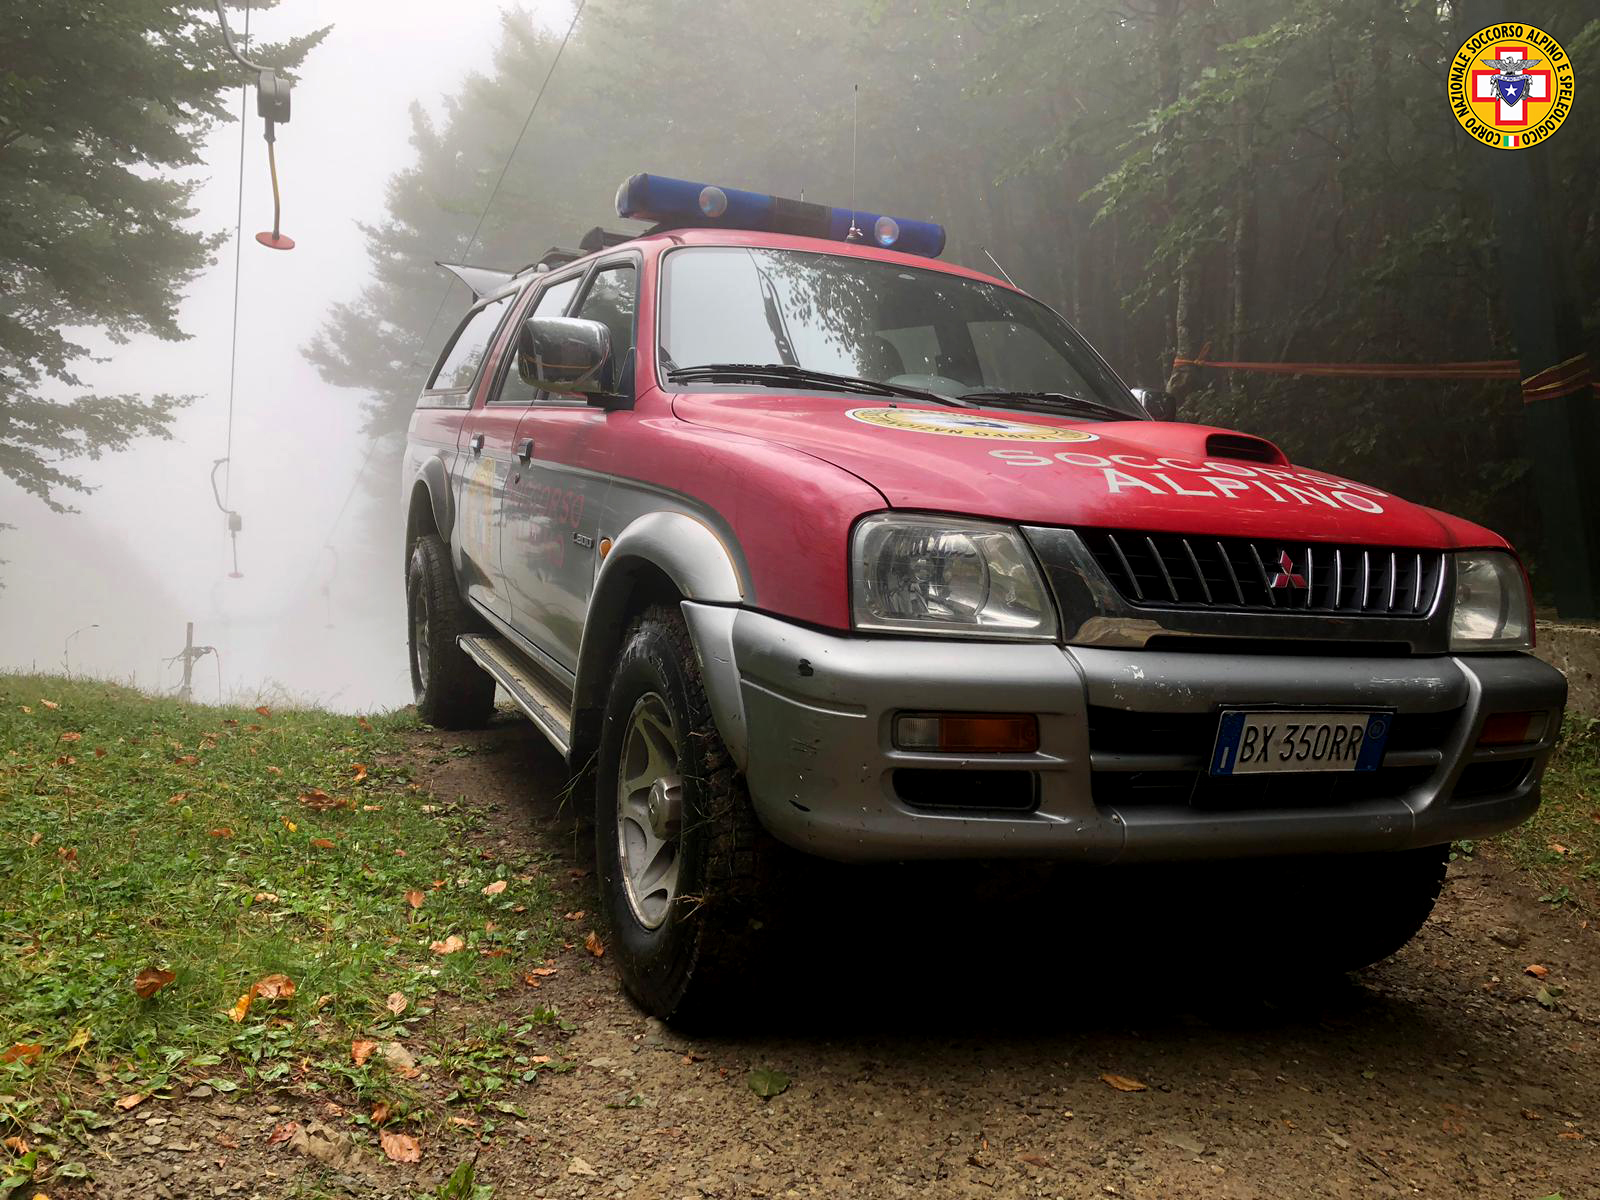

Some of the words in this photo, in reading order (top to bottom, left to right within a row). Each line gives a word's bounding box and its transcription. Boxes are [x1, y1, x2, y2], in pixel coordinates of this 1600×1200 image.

[988, 449, 1389, 498] SOCCORSO
[1102, 468, 1384, 514] ALPINO
[1239, 724, 1277, 763] BX
[1279, 724, 1364, 762] 350RR
